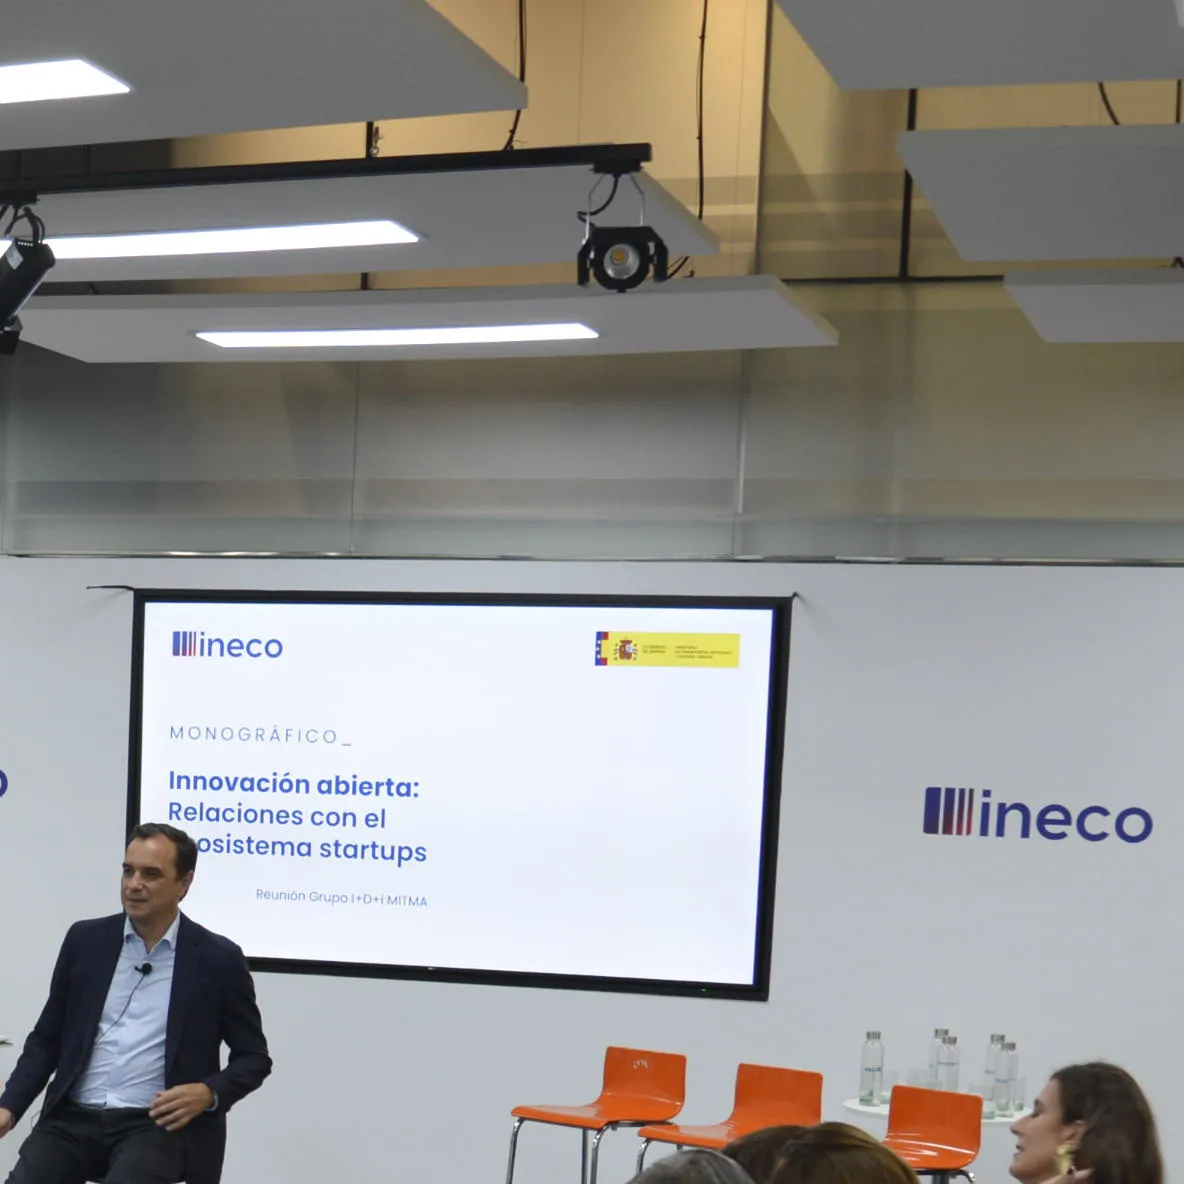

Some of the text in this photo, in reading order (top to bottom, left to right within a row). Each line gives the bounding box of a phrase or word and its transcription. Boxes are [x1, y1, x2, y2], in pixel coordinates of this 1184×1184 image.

[199, 631, 283, 658] ineco
[168, 770, 420, 798] Innovación abierta:
[168, 801, 386, 829] Relaciones con el
[979, 789, 1154, 843] ineco
[196, 833, 428, 868] osistema startups
[256, 887, 306, 902] Reunión
[309, 891, 348, 907] Grupo
[387, 895, 428, 907] MITMA
